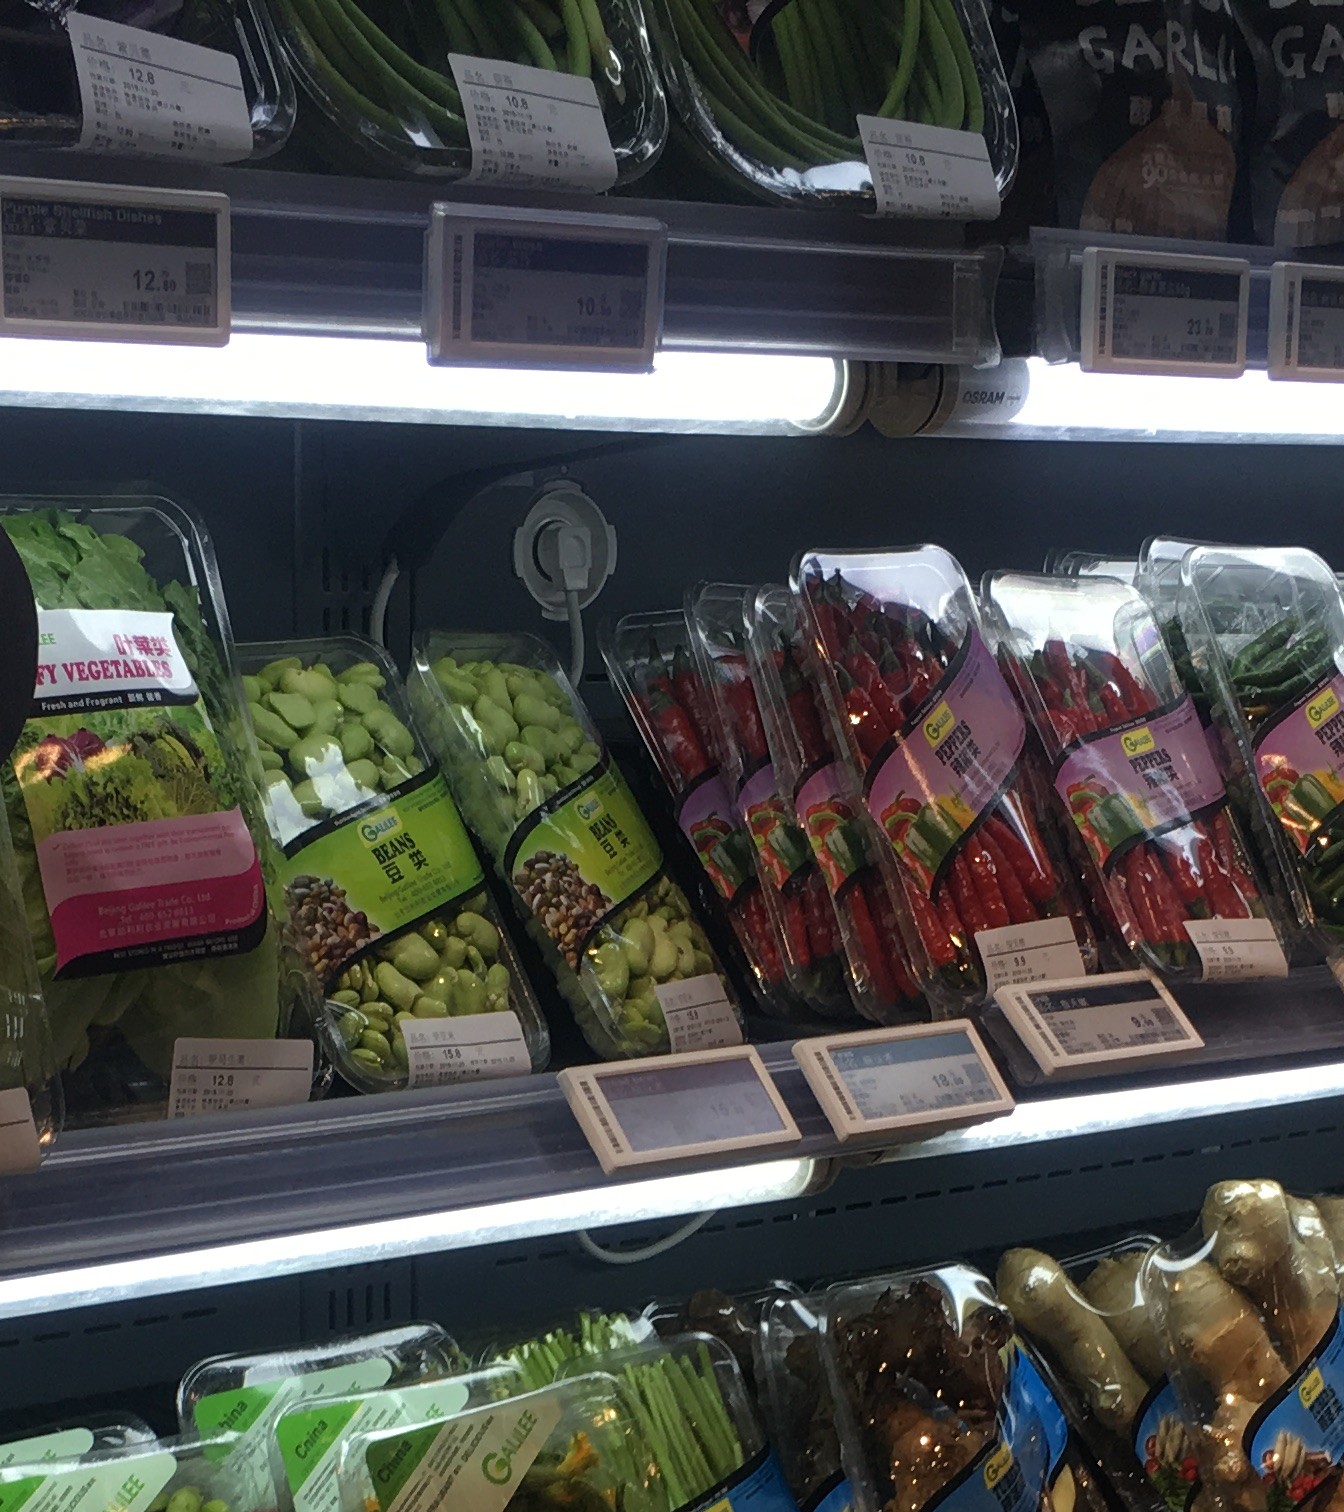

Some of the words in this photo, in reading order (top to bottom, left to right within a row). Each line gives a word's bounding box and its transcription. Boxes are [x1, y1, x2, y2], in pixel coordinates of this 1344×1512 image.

[129, 67, 155, 85] 12.8
[504, 93, 528, 110] 10.8
[113, 633, 173, 658] 叶菜类
[66, 658, 173, 681] VEGETABLES
[41, 700, 66, 712] Fresh
[86, 695, 123, 708] Fragrant
[371, 832, 416, 865] BEANS
[212, 1074, 234, 1086] 12.8
[295, 1419, 329, 1460] China
[481, 1408, 538, 1485] GALILEE
[377, 1439, 413, 1484] China
